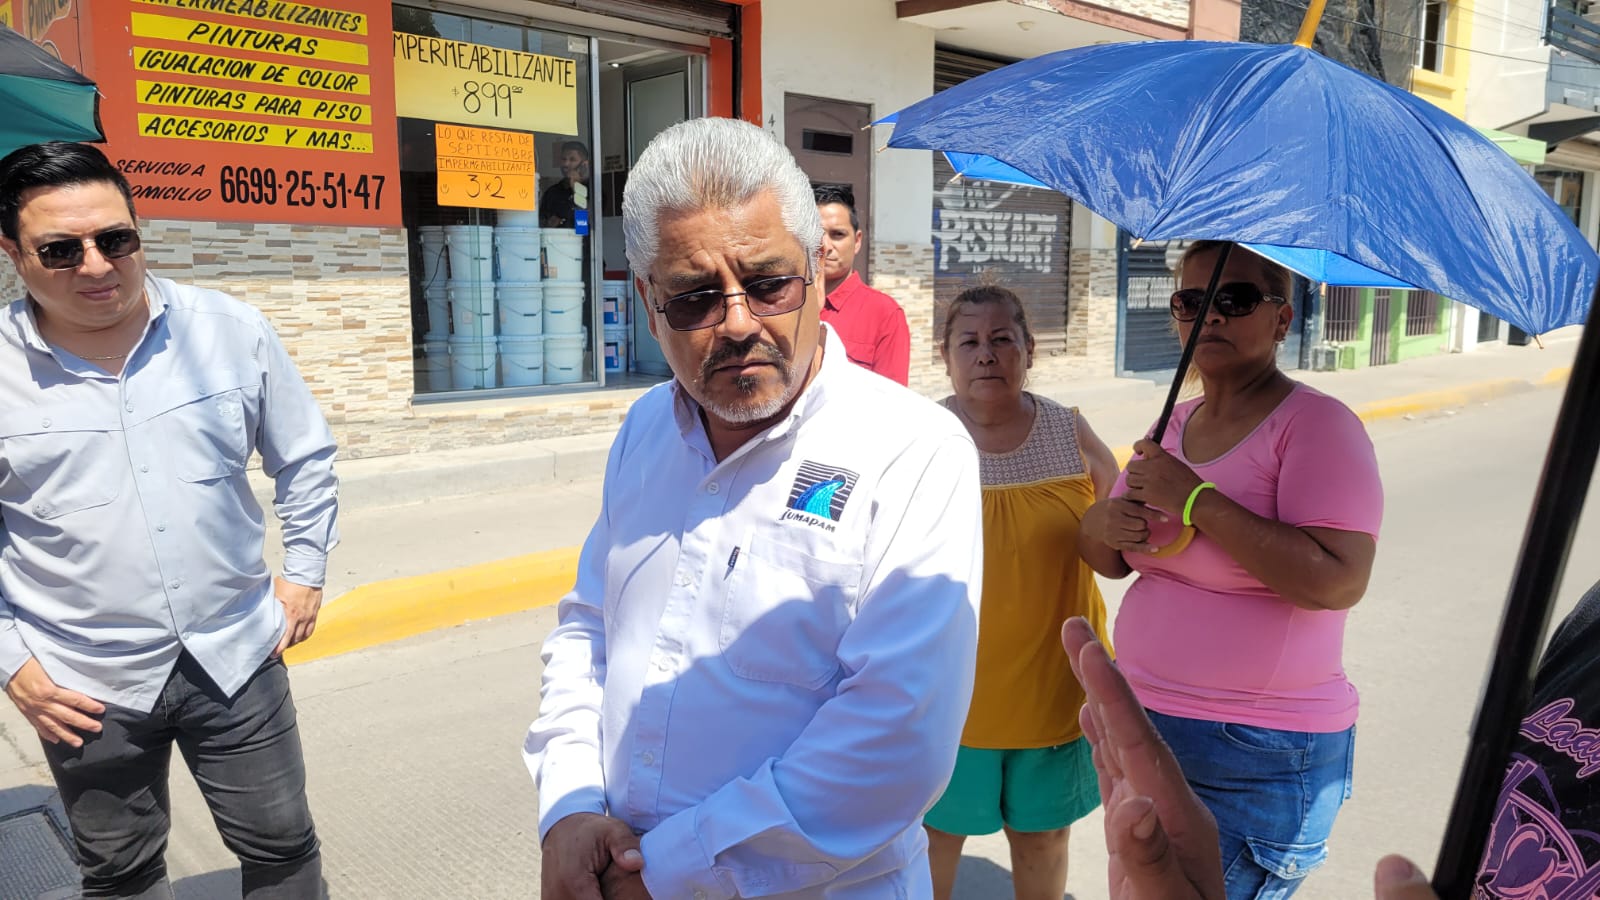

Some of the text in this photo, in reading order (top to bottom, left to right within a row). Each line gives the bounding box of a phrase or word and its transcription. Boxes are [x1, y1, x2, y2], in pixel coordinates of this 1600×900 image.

[186, 22, 318, 55] PINTURAS
[138, 49, 359, 91] IGUALACION DE COLOR
[392, 33, 575, 88] MPERMEABILIZANTE
[144, 82, 362, 122] PINTURAS PARA PISO
[144, 116, 366, 150] ACCESORIOS Y MAS...
[437, 126, 530, 146] LO QUE RESTA DE
[448, 141, 533, 160] SEPTIEMBRE
[116, 159, 206, 177] SERVICIO A
[438, 157, 532, 173] IMPERMEABILIZANTE
[131, 184, 212, 202] OMICILIO
